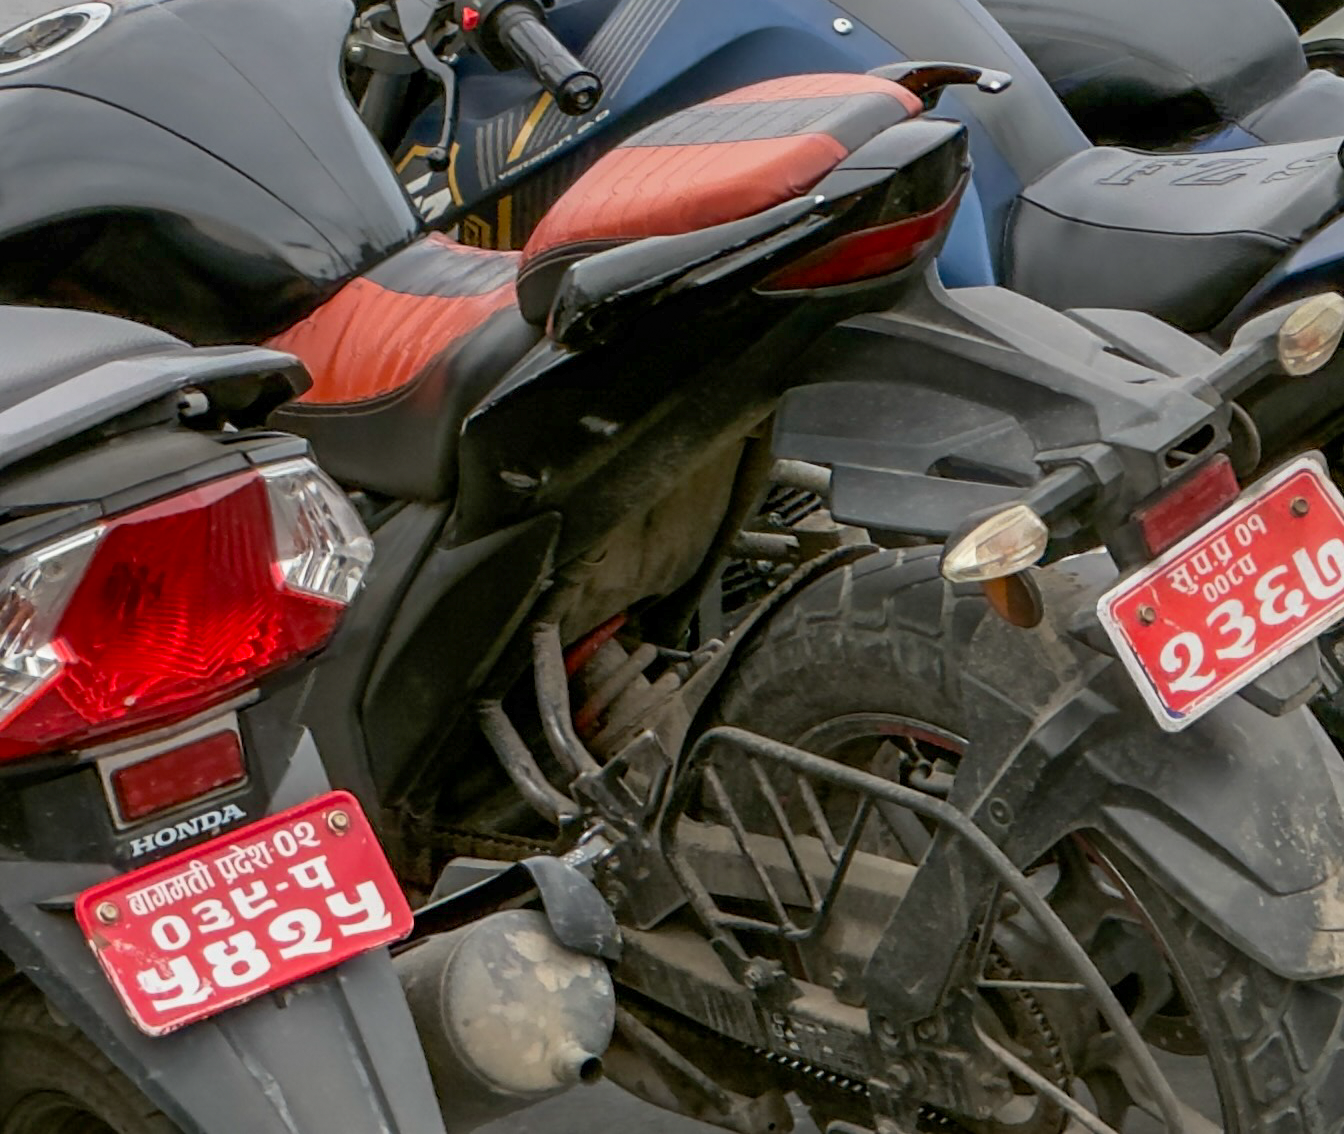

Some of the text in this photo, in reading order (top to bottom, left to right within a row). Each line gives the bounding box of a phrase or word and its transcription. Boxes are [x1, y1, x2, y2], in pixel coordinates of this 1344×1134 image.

[129, 803, 247, 857] HONDA
[125, 842, 216, 916] बागमती
[136, 880, 393, 1012] ५४२५
